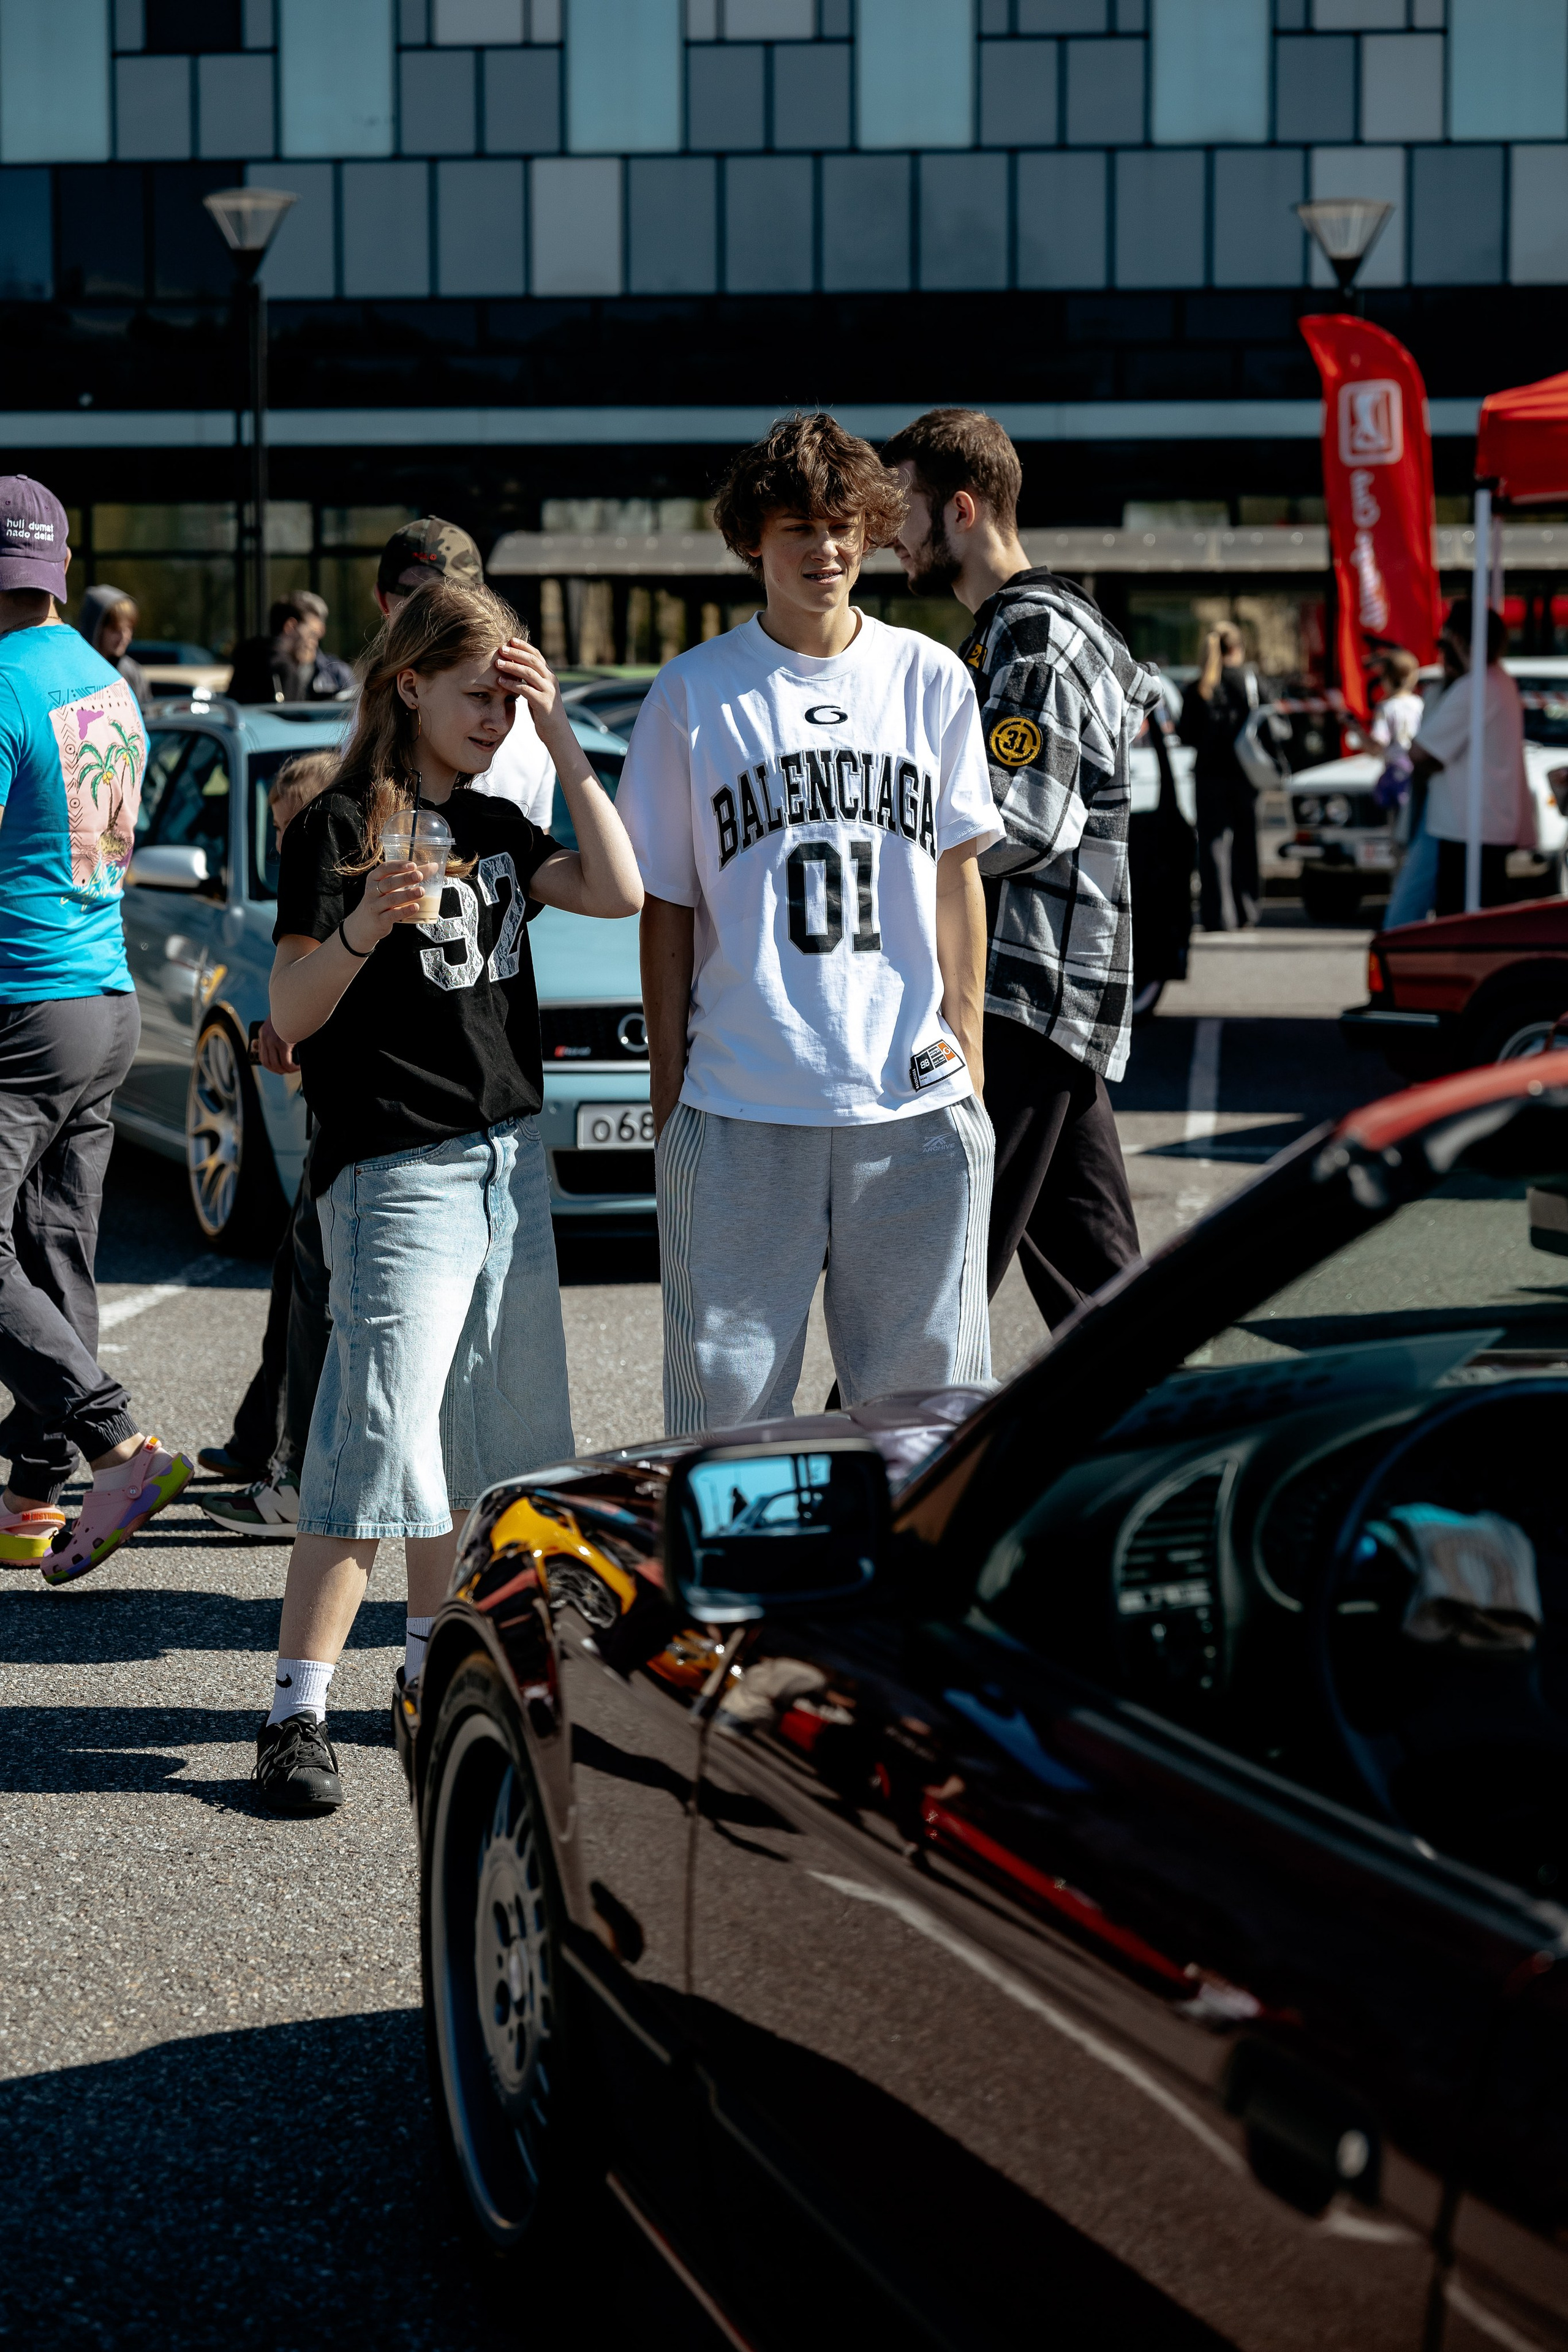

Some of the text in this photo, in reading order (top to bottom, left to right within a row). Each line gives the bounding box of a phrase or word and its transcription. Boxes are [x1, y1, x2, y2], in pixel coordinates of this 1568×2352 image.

[6, 529, 31, 538] nado
[28, 521, 54, 532] dumat
[1004, 729, 1028, 754] 31
[711, 747, 937, 872] BALENCIAGA
[785, 839, 883, 956] 01
[416, 851, 527, 991] 92
[922, 1142, 956, 1153] ARCHIVE
